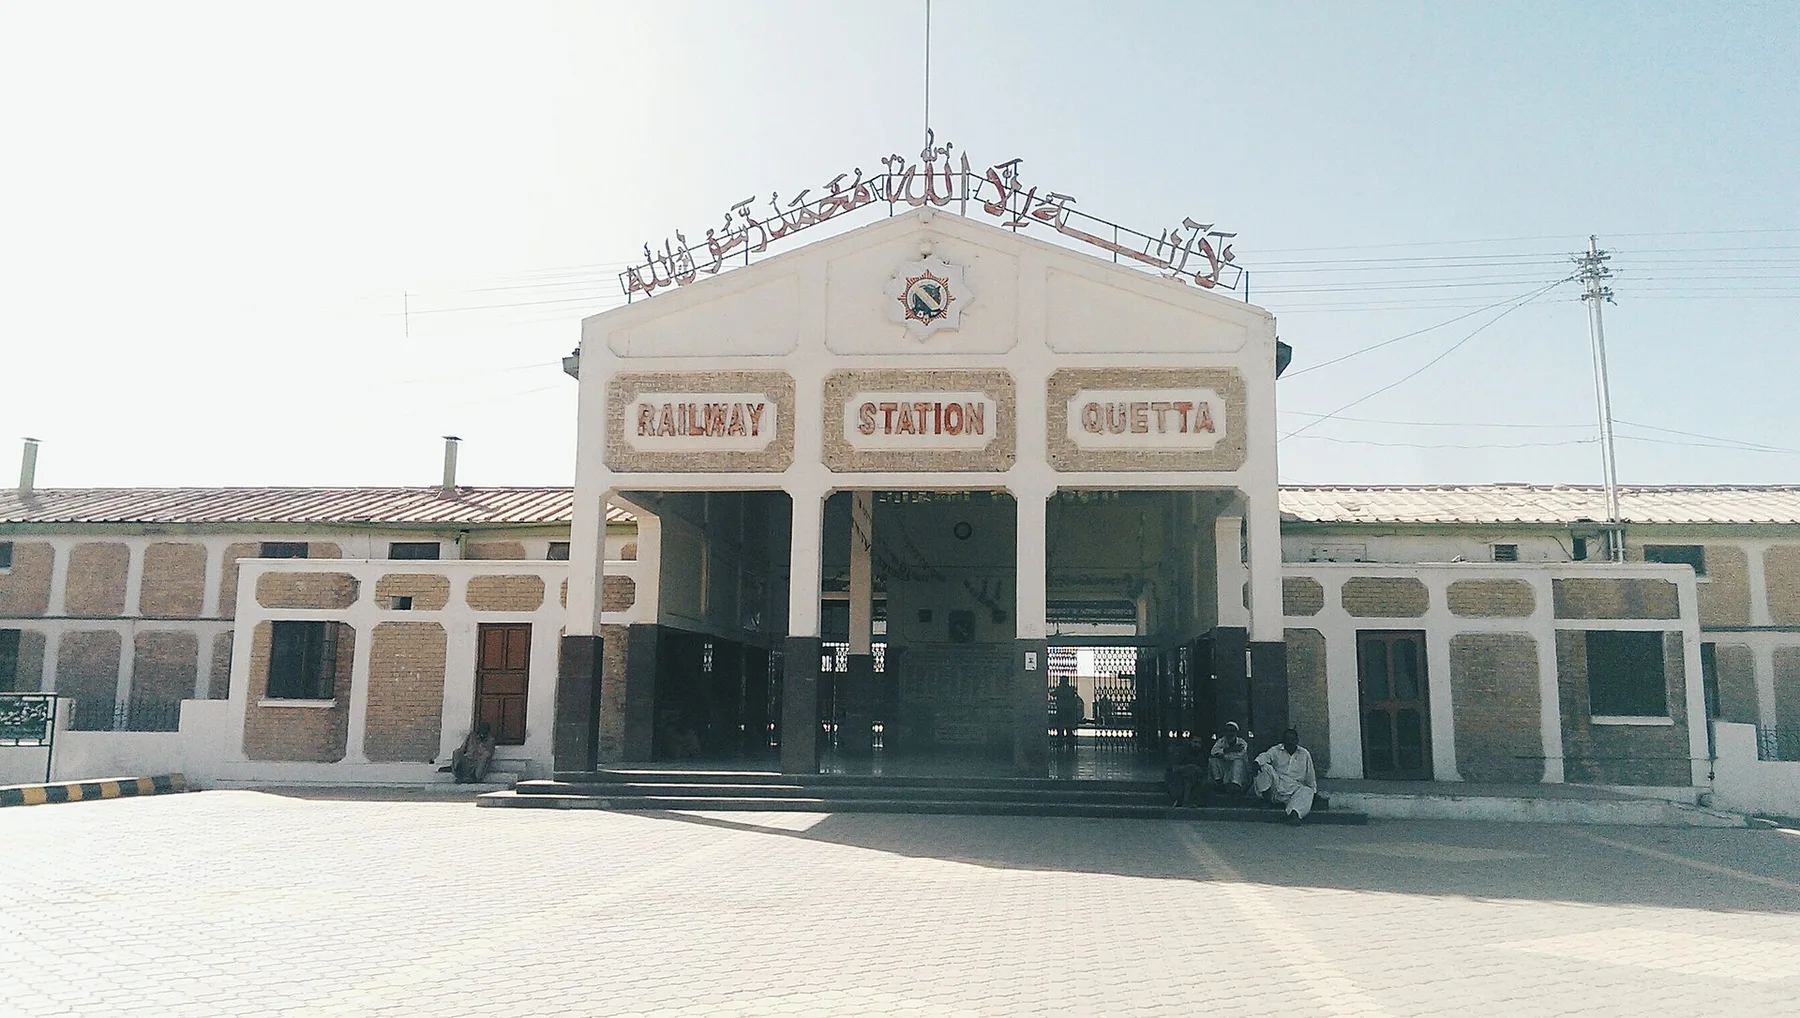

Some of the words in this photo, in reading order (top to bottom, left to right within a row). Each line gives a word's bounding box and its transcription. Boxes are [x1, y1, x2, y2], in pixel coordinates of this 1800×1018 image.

[637, 401, 765, 437] RAILWAY
[858, 402, 985, 435] STATION
[1081, 401, 1216, 434] QUETTA
